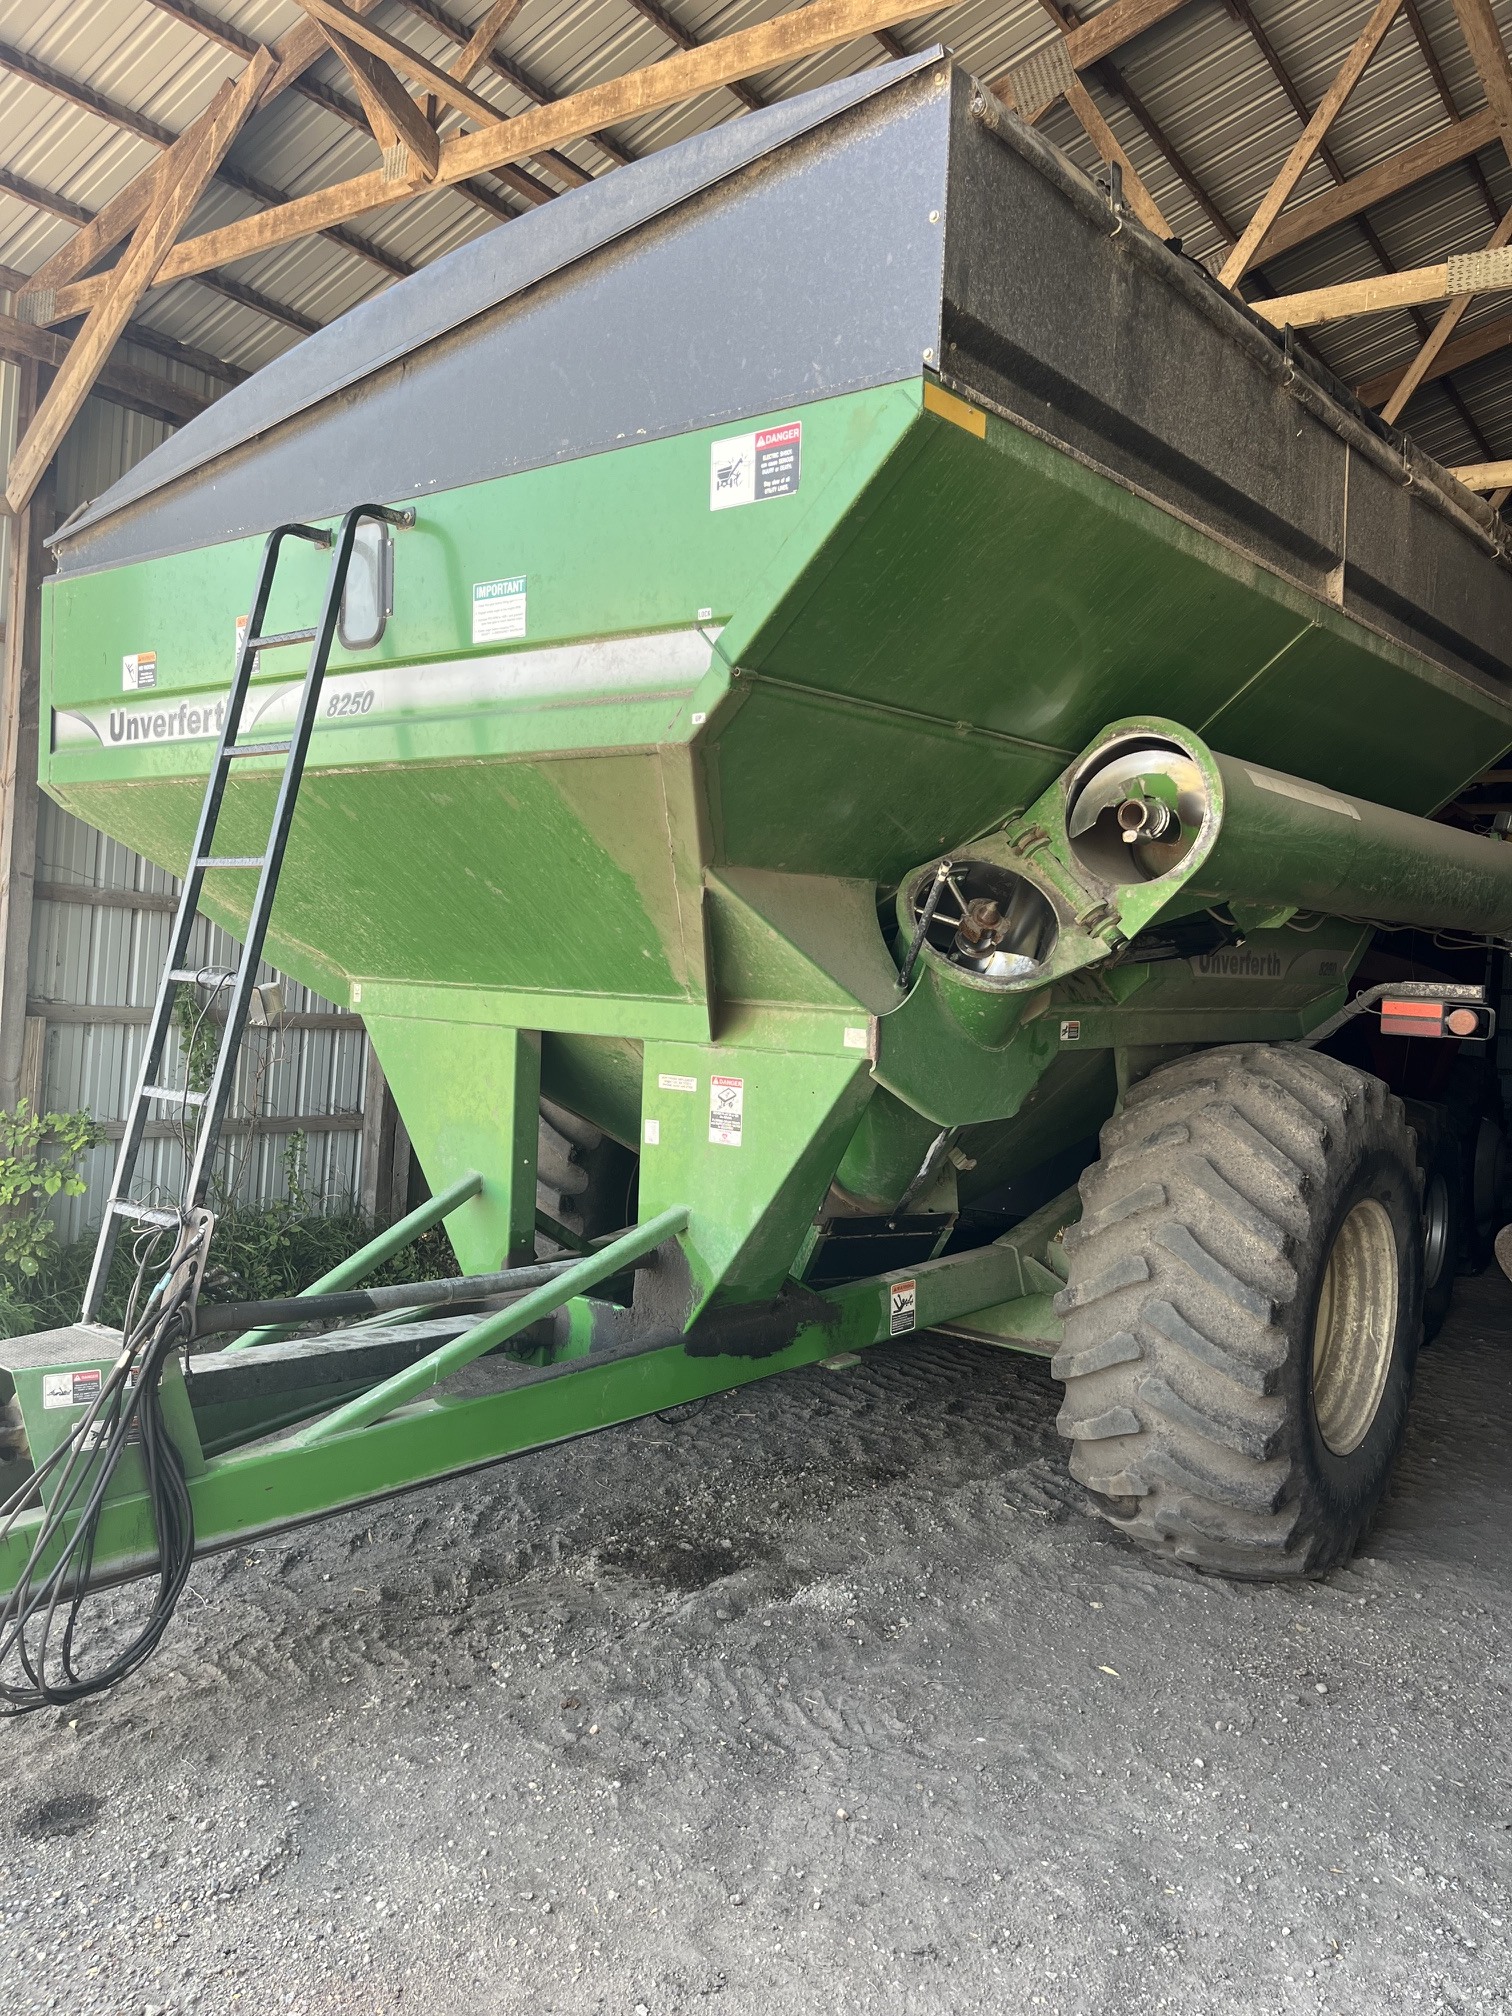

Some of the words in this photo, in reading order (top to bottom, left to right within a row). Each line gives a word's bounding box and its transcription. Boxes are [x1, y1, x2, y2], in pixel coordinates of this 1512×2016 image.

[766, 428, 799, 445] DANGER
[476, 579, 525, 599] IMPORTANT
[699, 610, 711, 618] LOCK
[326, 689, 375, 717] 8250
[110, 701, 225, 741] Unverfert
[1199, 951, 1281, 976] Unverferth
[719, 1078, 742, 1087] DANGER
